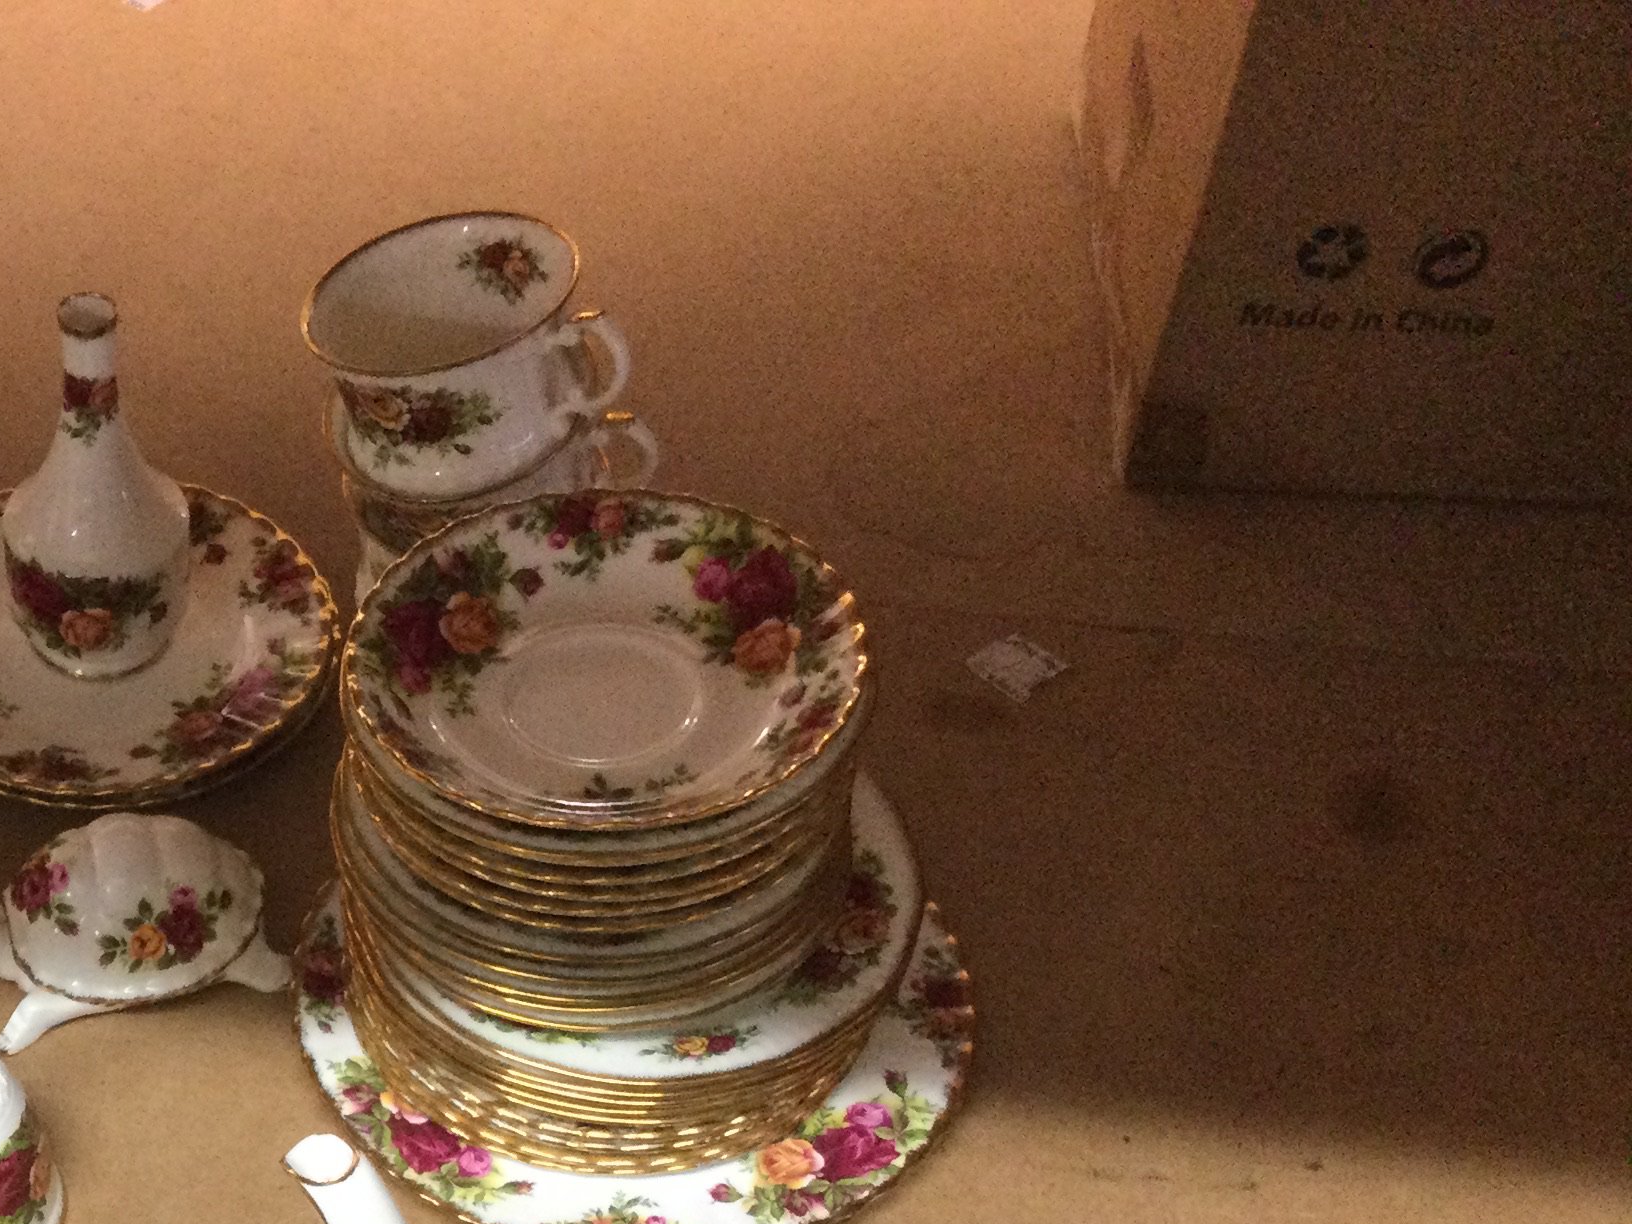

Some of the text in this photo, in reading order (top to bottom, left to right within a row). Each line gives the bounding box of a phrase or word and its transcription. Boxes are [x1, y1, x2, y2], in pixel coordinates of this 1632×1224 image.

[1239, 302, 1495, 335] Made in China
